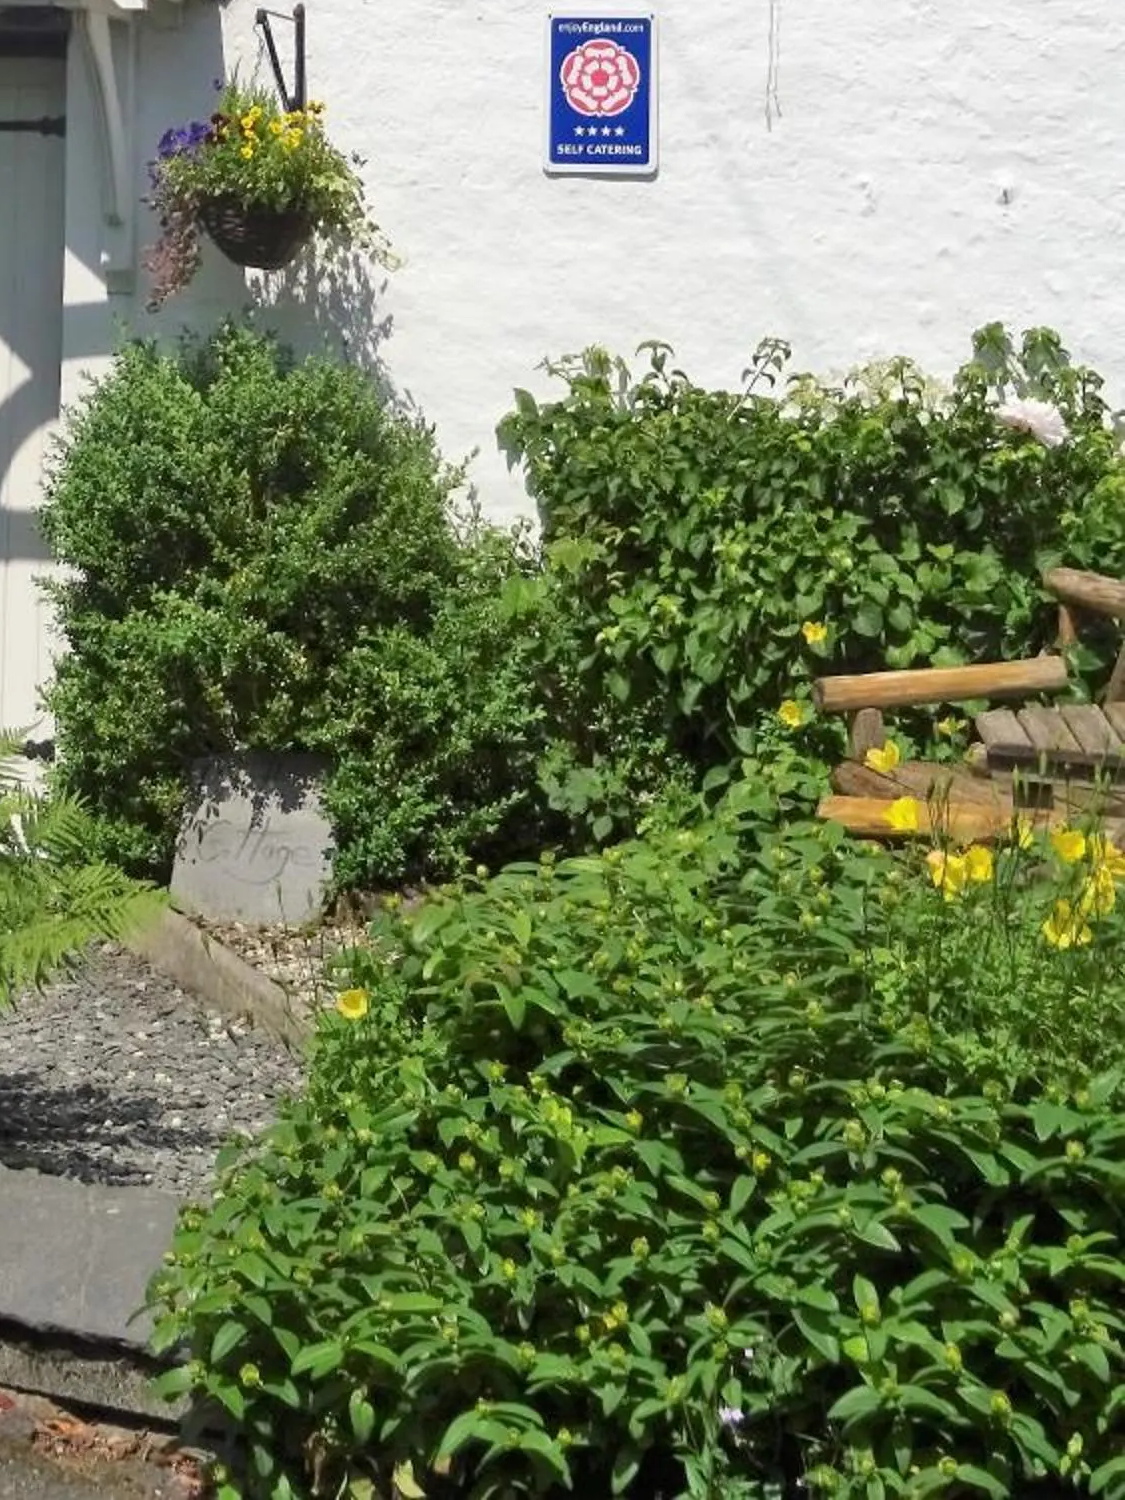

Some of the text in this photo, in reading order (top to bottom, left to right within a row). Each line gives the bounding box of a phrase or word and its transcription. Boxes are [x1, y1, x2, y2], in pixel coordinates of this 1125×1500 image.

[558, 21, 644, 34] enjoyEngland.com
[557, 143, 642, 155] SELF CATERING
